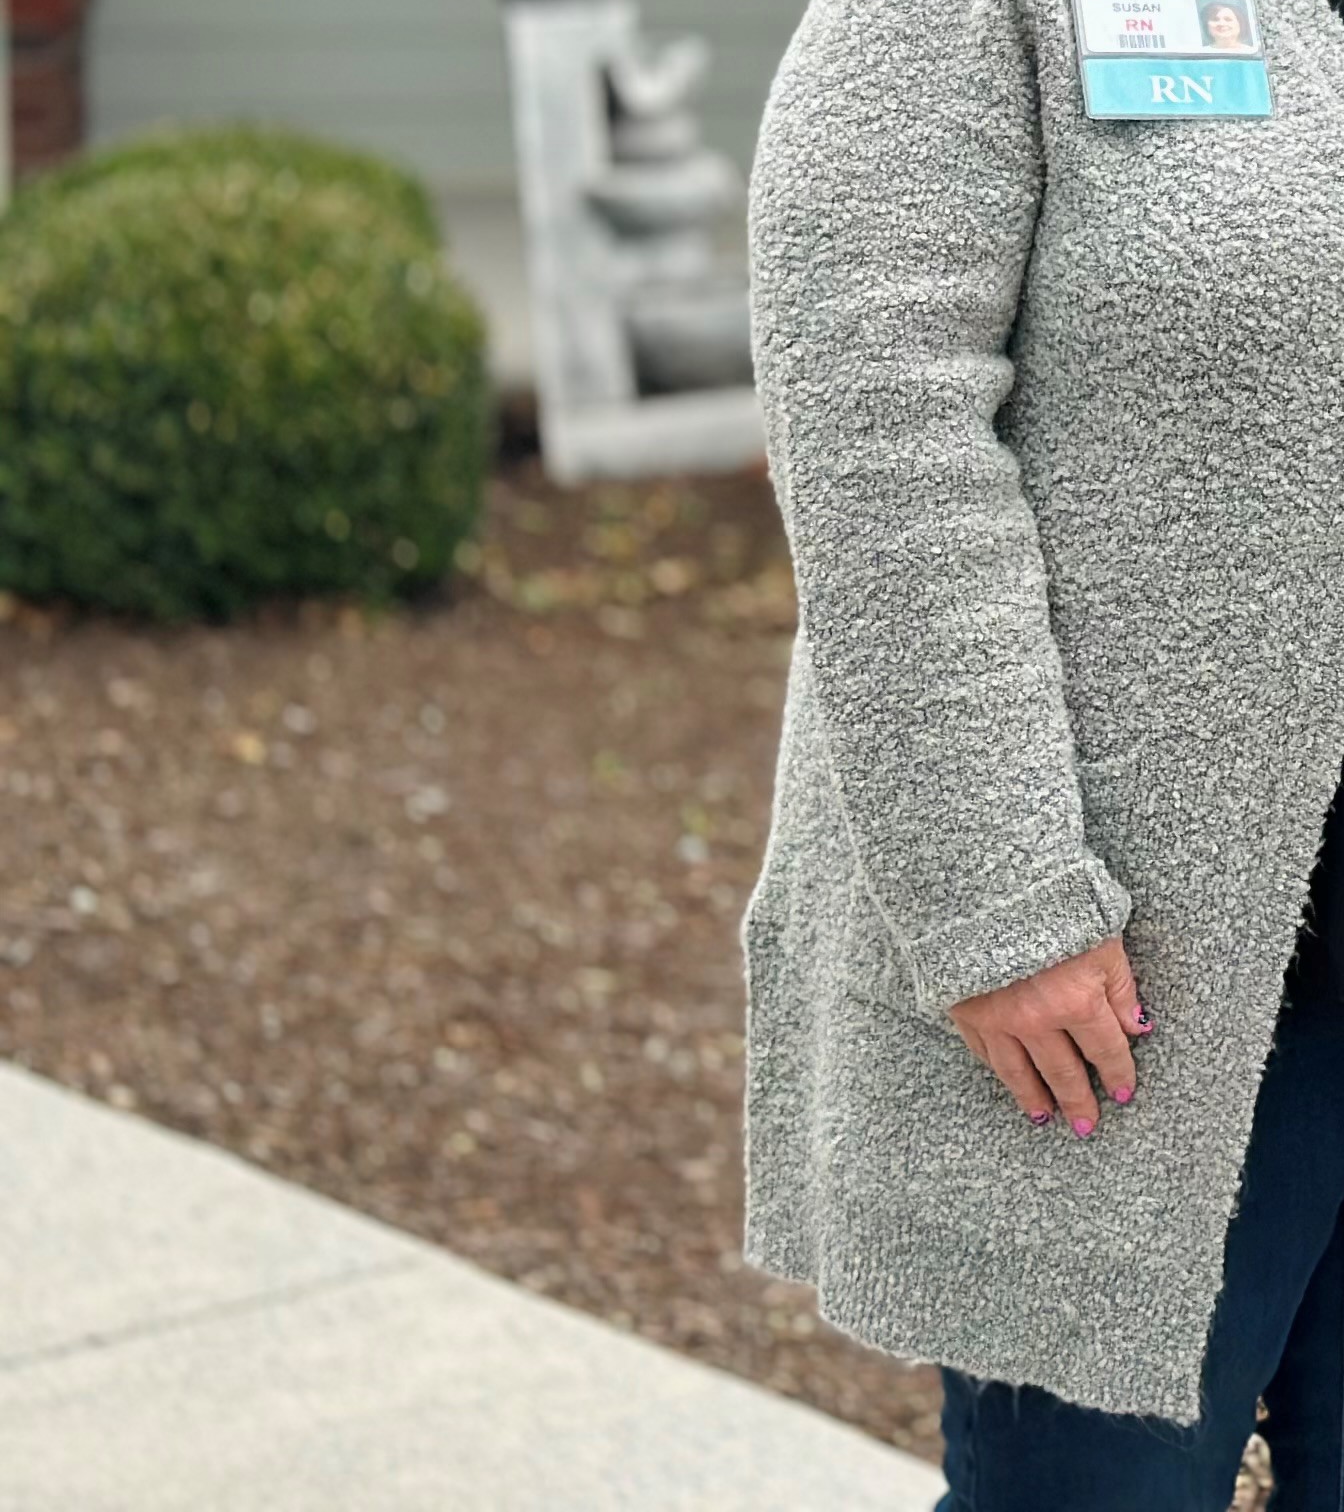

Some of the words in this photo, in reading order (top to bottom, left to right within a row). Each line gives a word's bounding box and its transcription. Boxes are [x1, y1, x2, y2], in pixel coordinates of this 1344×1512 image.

[1112, 3, 1161, 13] SUSAN
[1125, 19, 1154, 31] RN
[1149, 74, 1215, 104] RN
